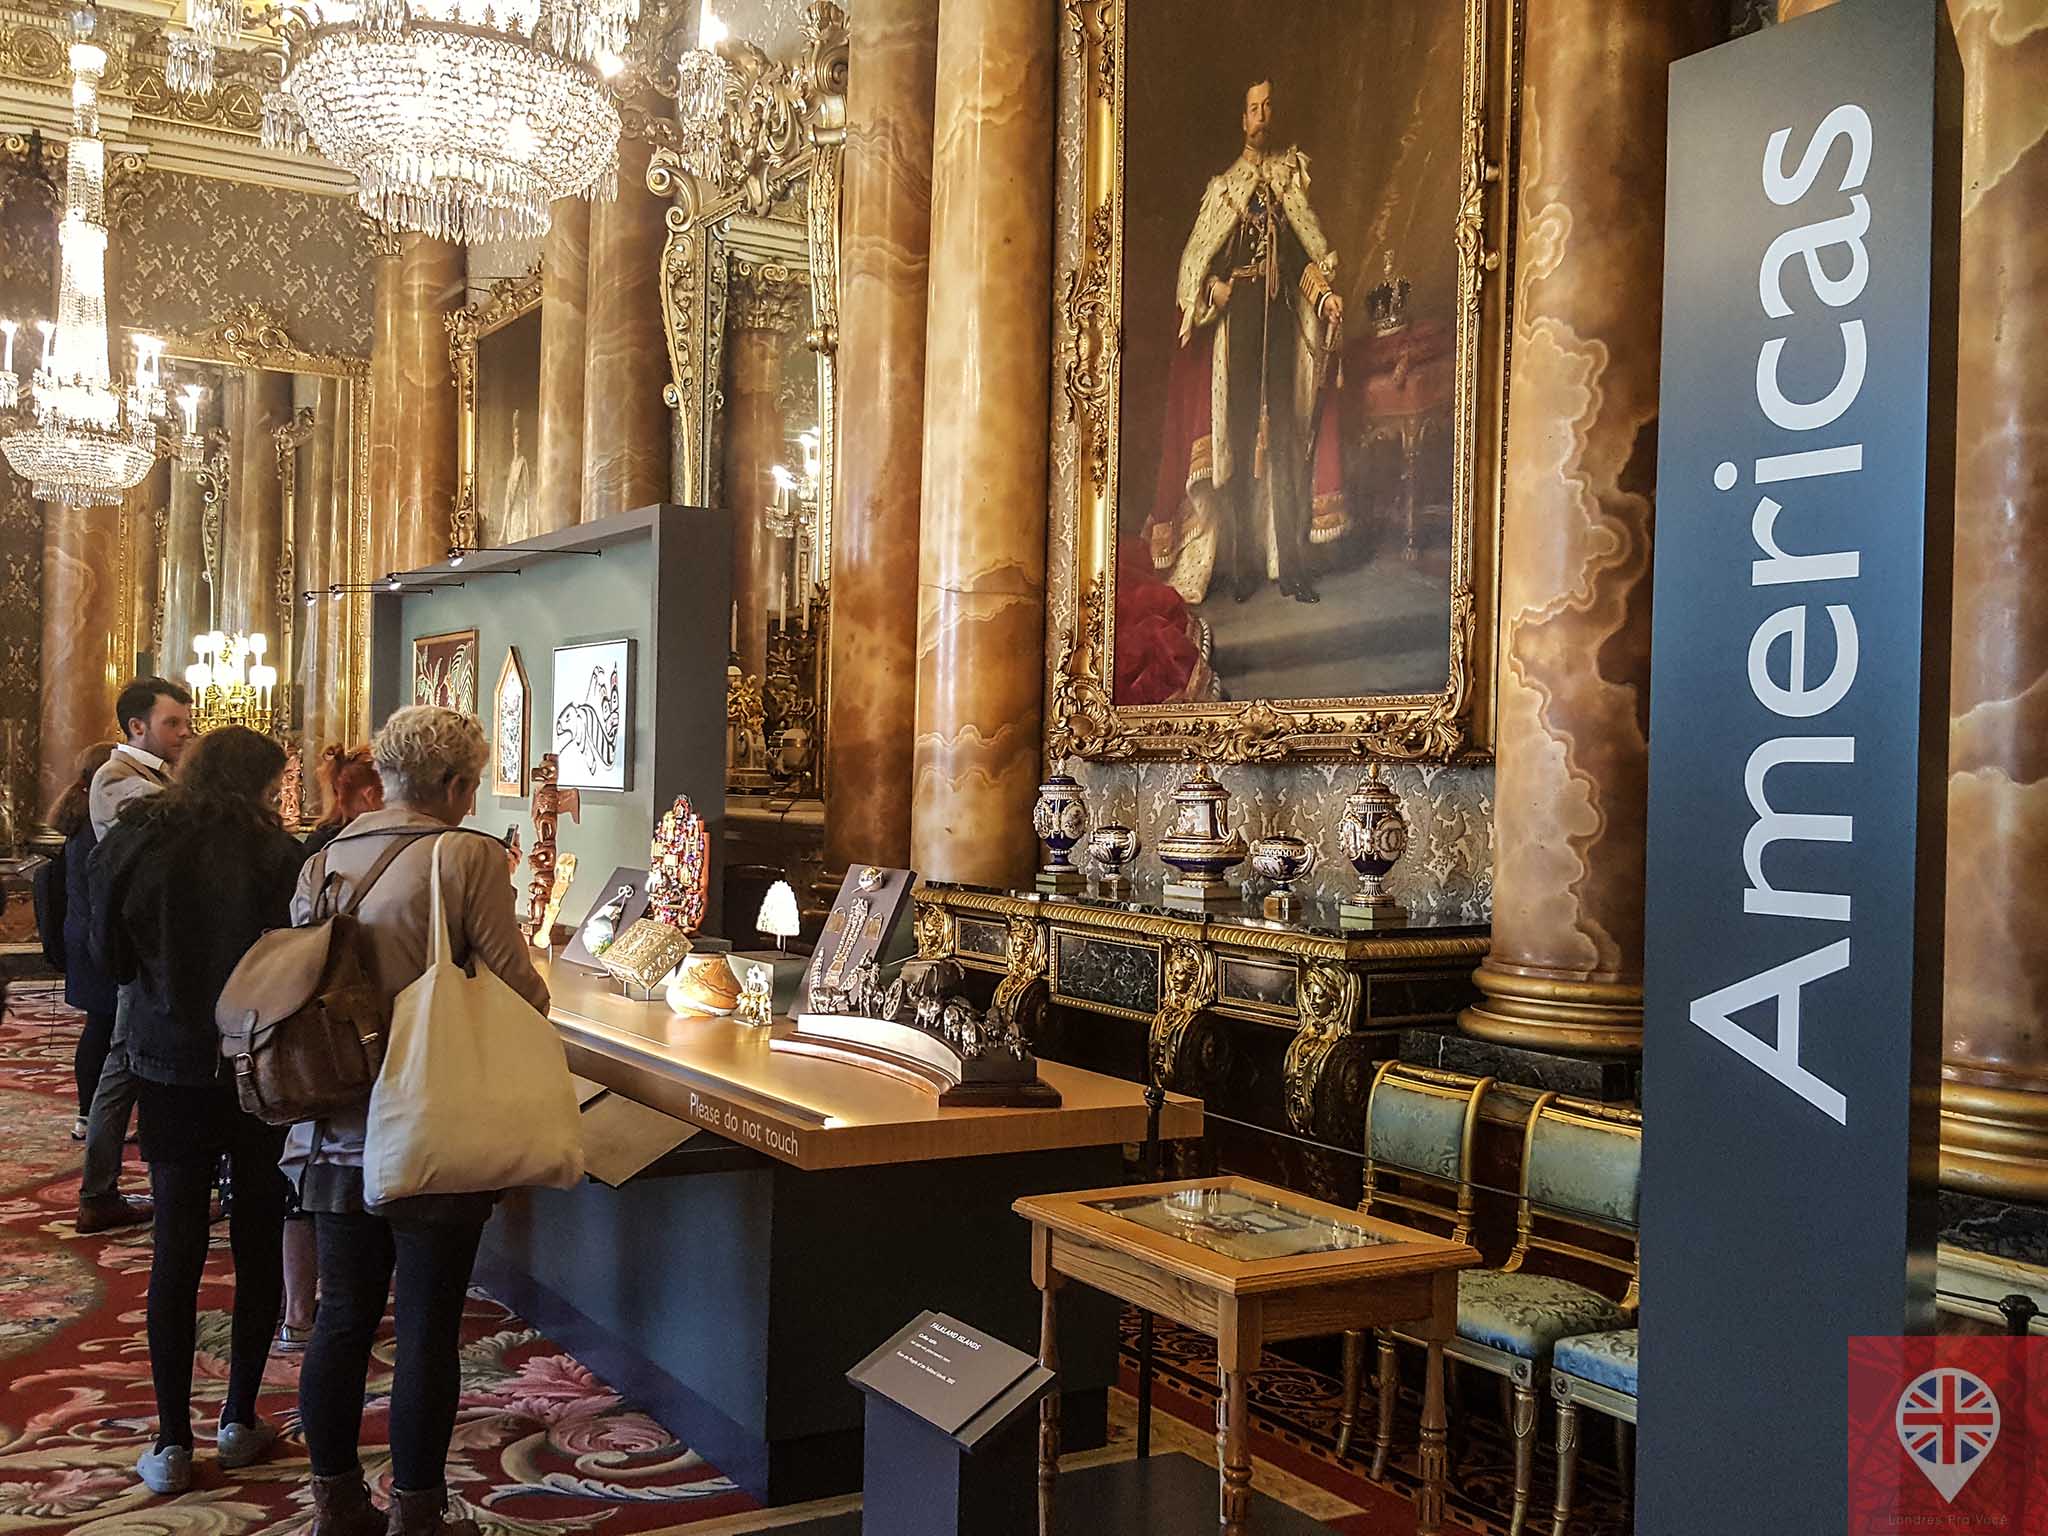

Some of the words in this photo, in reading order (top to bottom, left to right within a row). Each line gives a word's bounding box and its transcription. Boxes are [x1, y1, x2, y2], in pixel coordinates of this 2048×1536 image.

[1690, 104, 1873, 1125] Americas
[689, 1092, 720, 1125] Please
[724, 1107, 738, 1131] do
[742, 1119, 761, 1141] not
[765, 1128, 798, 1156] touch
[930, 1322, 958, 1339] FALKLAND
[957, 1335, 982, 1350] ISLANDS
